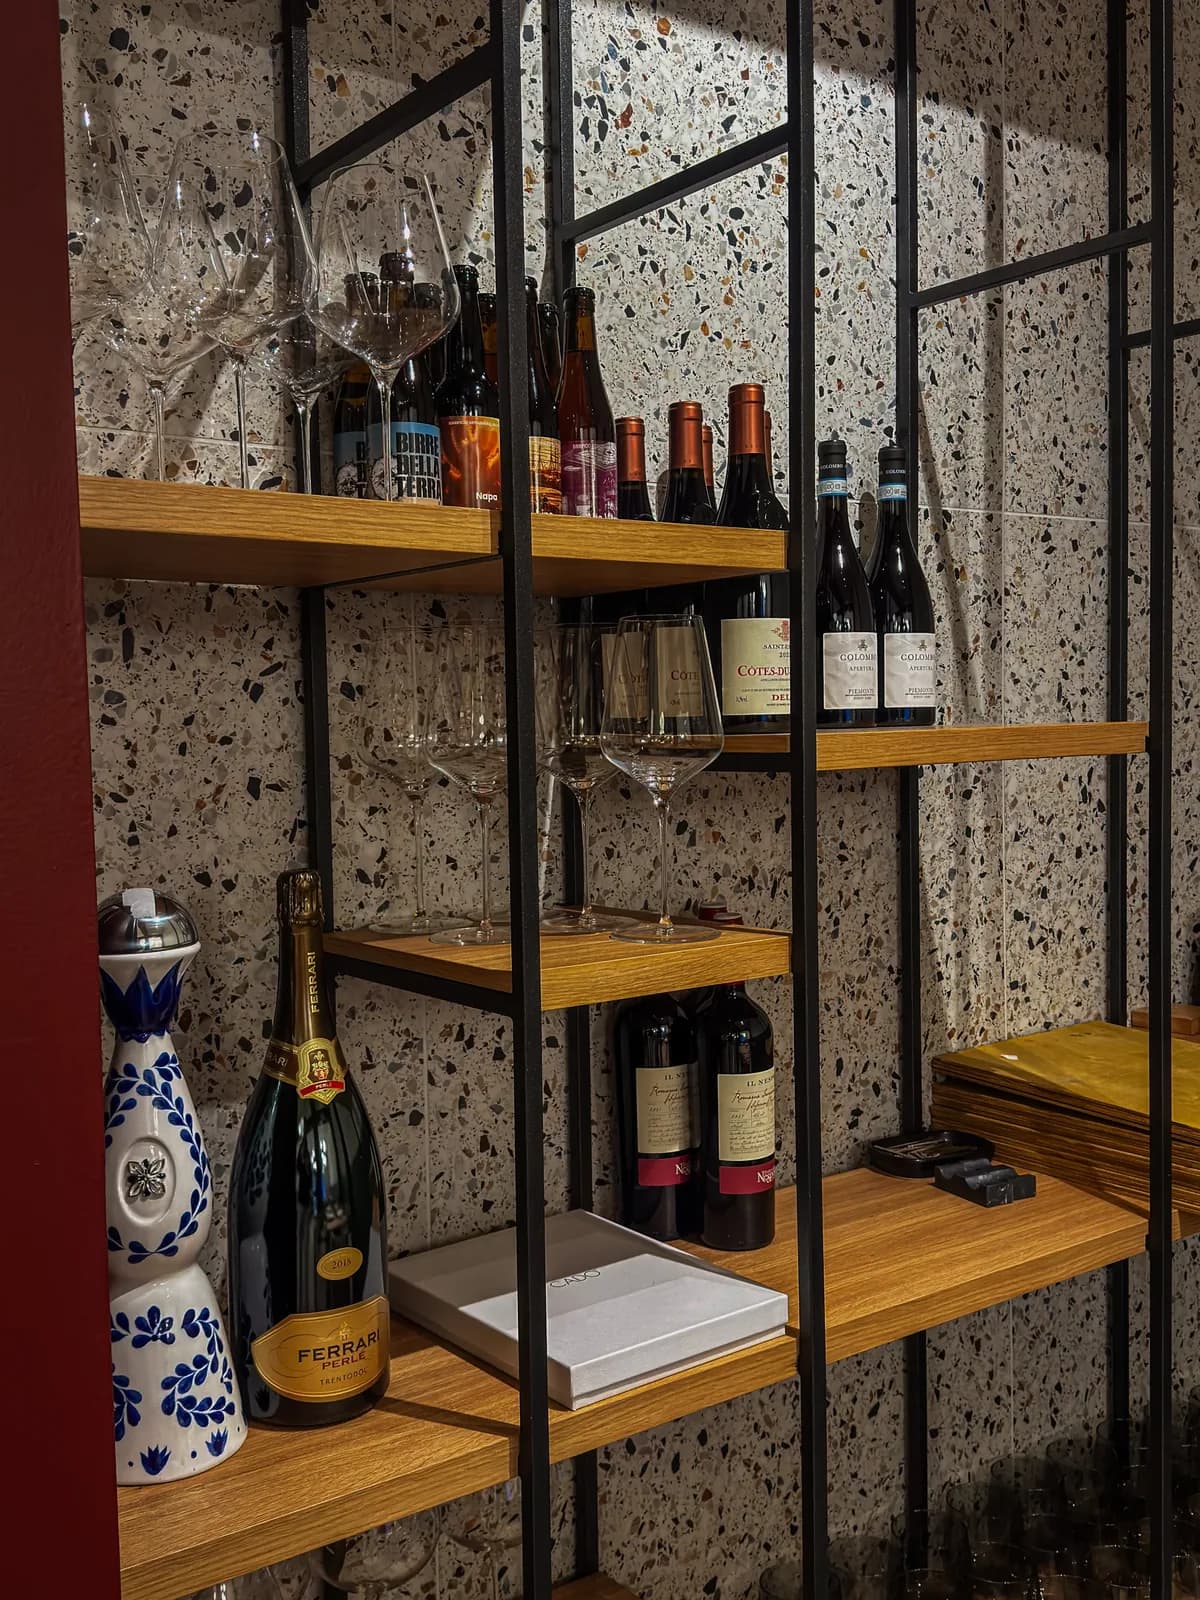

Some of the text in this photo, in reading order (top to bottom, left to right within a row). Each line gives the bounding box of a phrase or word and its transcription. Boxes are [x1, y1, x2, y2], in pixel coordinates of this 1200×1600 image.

[396, 432, 440, 457] BIRRE
[475, 491, 498, 503] Napa
[307, 951, 320, 1014] FERRARI
[298, 1328, 381, 1364] FERRARI
